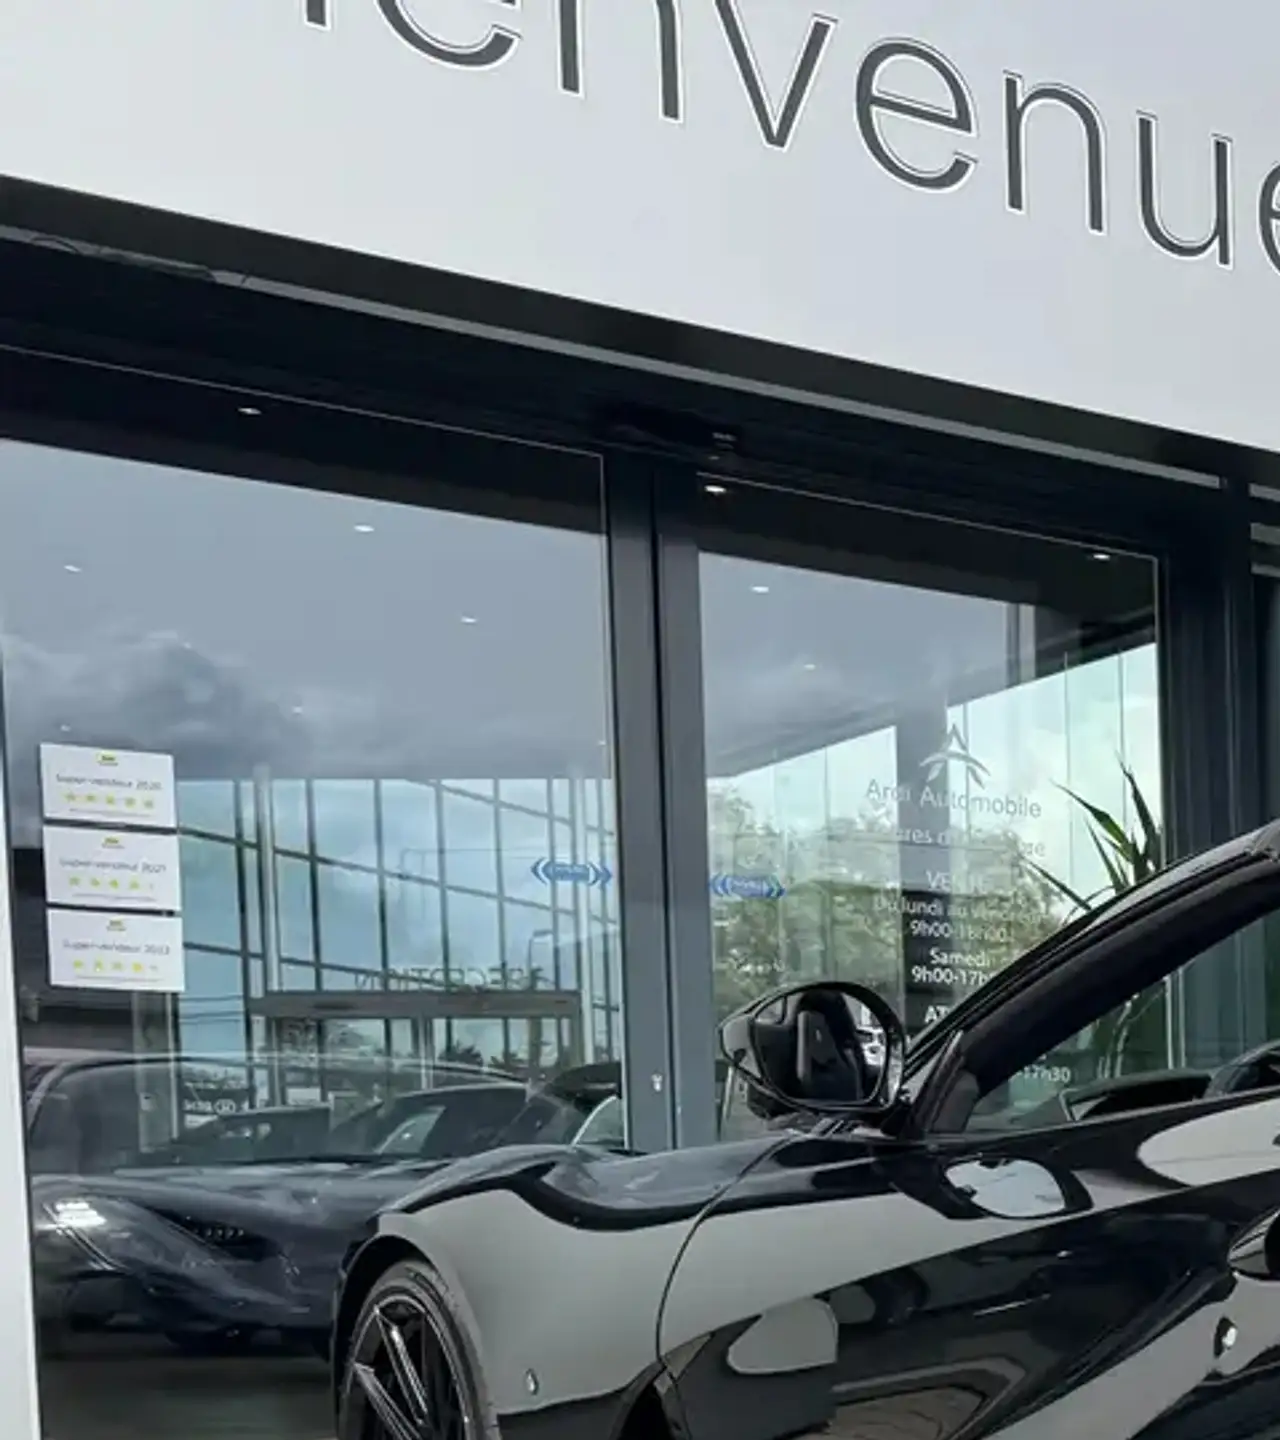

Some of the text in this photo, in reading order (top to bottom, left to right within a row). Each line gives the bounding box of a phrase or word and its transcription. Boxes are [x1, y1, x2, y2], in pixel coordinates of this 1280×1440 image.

[919, 785, 1042, 819] Automobile
[902, 894, 944, 917] lundi
[929, 947, 989, 968] Samedi
